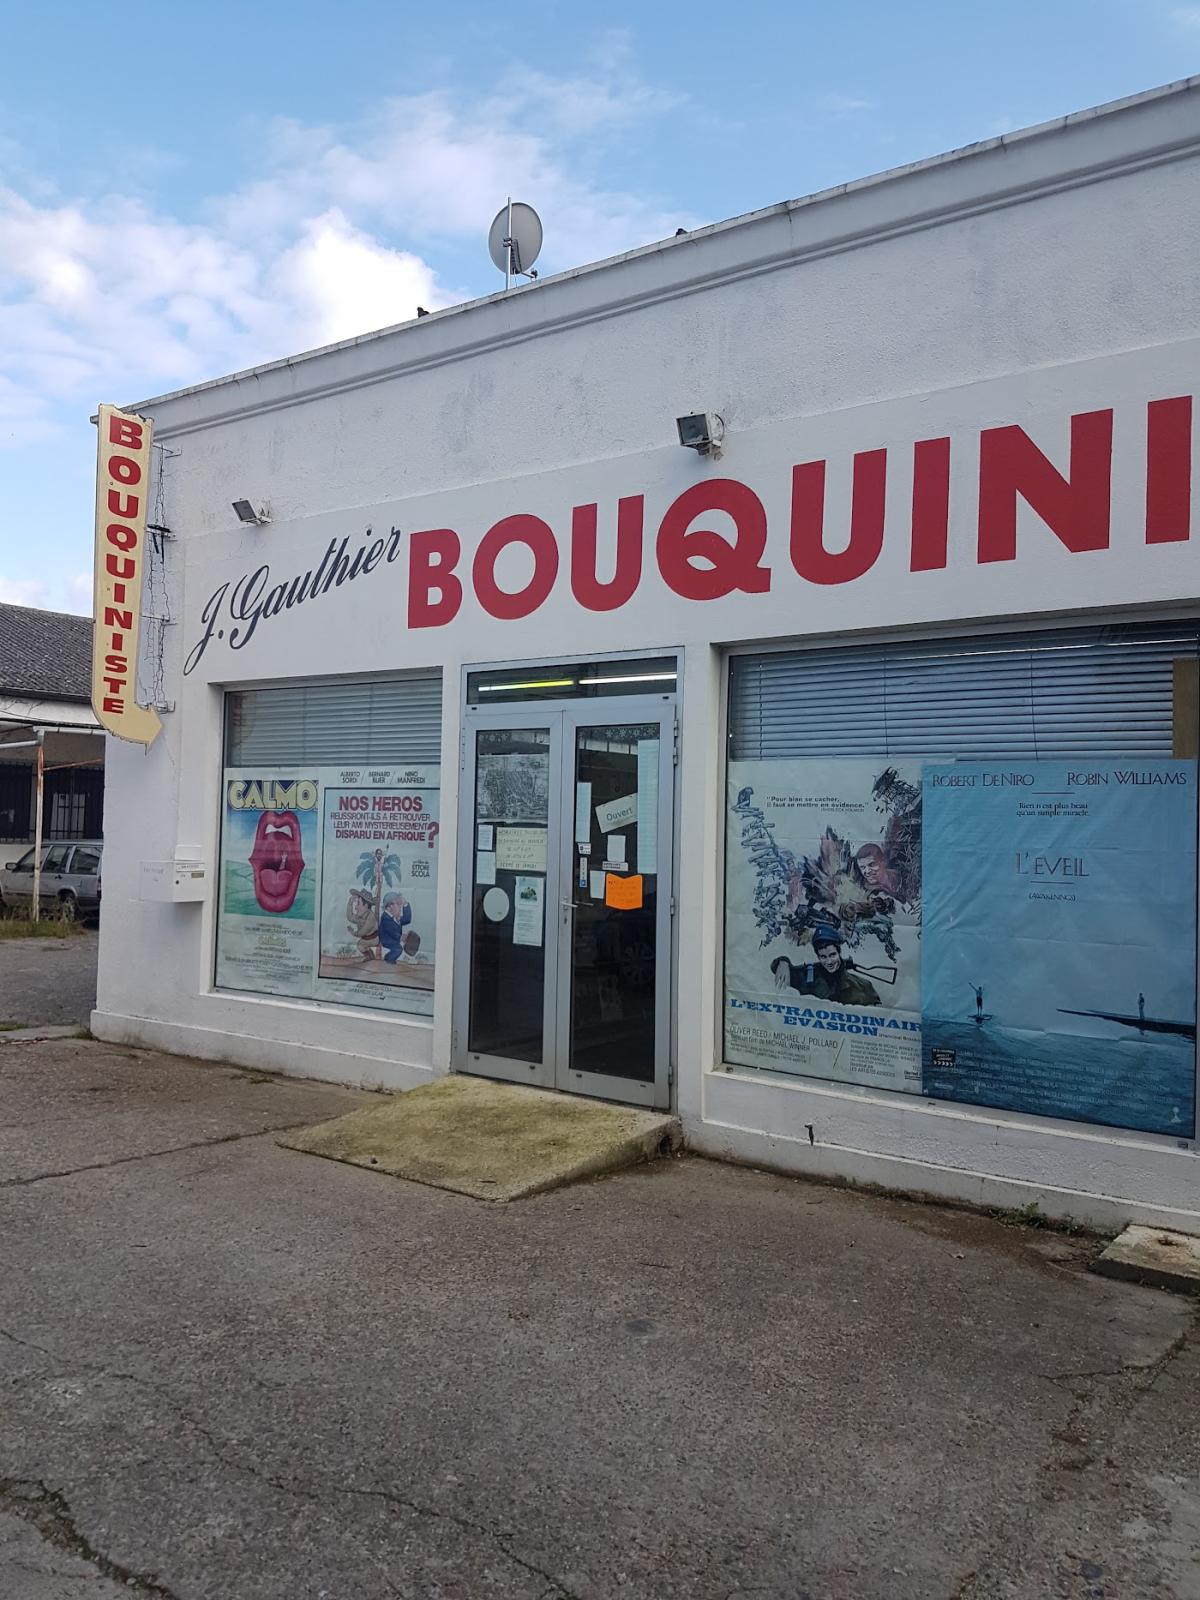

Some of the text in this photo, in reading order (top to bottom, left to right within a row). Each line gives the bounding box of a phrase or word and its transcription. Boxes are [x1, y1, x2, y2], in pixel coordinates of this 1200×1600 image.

[407, 394, 1193, 629] BOUQUINI
[102, 415, 143, 715] BOUQUINISTE
[932, 773, 977, 787] ROBERT
[1067, 770, 1188, 786] ROBIN WILLIAMS
[339, 795, 423, 812] NOS HEROS
[389, 813, 431, 822] RETROUVER
[606, 807, 633, 821] Ouvert
[333, 820, 427, 831] LEUR AMI MYSTERIEUSEMENT
[335, 829, 372, 840] DISPARU
[373, 830, 385, 840] EN
[386, 830, 426, 842] AFRIQUE
[783, 1015, 878, 1037] EVASION
[773, 1031, 799, 1044] MICHAEL
[808, 1037, 838, 1049] POLLARD
